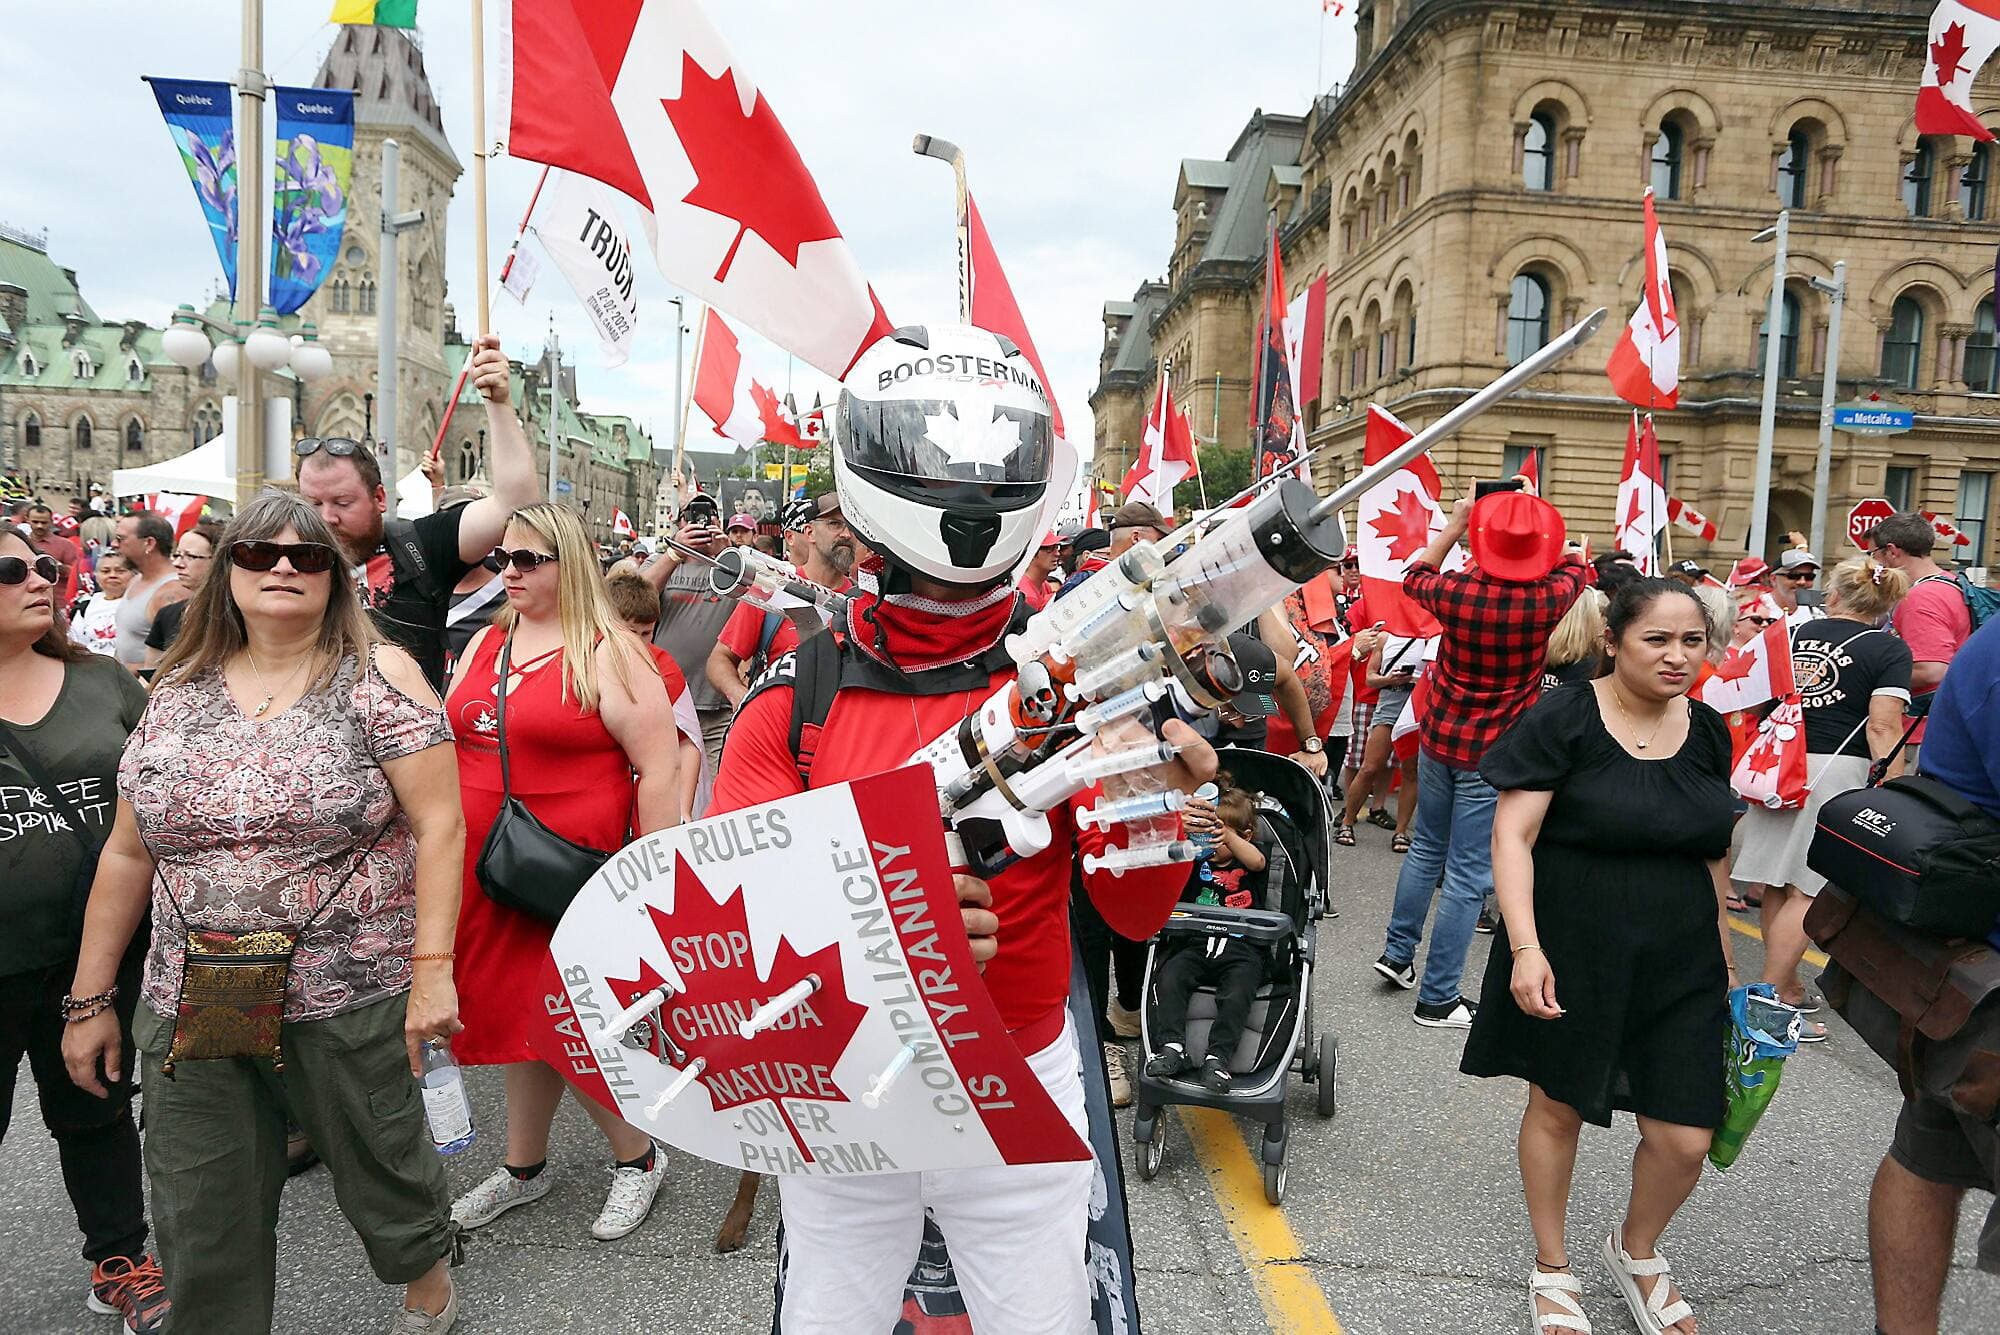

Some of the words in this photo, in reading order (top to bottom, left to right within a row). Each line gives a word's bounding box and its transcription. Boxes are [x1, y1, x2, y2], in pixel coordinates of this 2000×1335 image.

[176, 93, 213, 106] Québec
[297, 102, 334, 115] Quebec
[580, 207, 634, 302] TRUCK
[1854, 412, 1893, 425] Metcalfe
[1851, 515, 1889, 535] STO
[1798, 640, 1853, 667] YEARS
[1802, 690, 1847, 708] 2022
[1857, 807, 1887, 825] DVC
[601, 838, 670, 903] LOVE
[688, 808, 792, 865] RULES
[671, 930, 748, 974] STOP
[871, 840, 980, 1048] TYRANNY
[563, 964, 606, 1031] JAB
[831, 847, 970, 1117] COMPLIANCE
[544, 991, 598, 1075] FEAR
[595, 1046, 640, 1105] THE
[705, 1061, 836, 1105] NATURE
[967, 1074, 1015, 1111] IS
[742, 1100, 837, 1137] OVER
[739, 1140, 899, 1176] PHARMA
